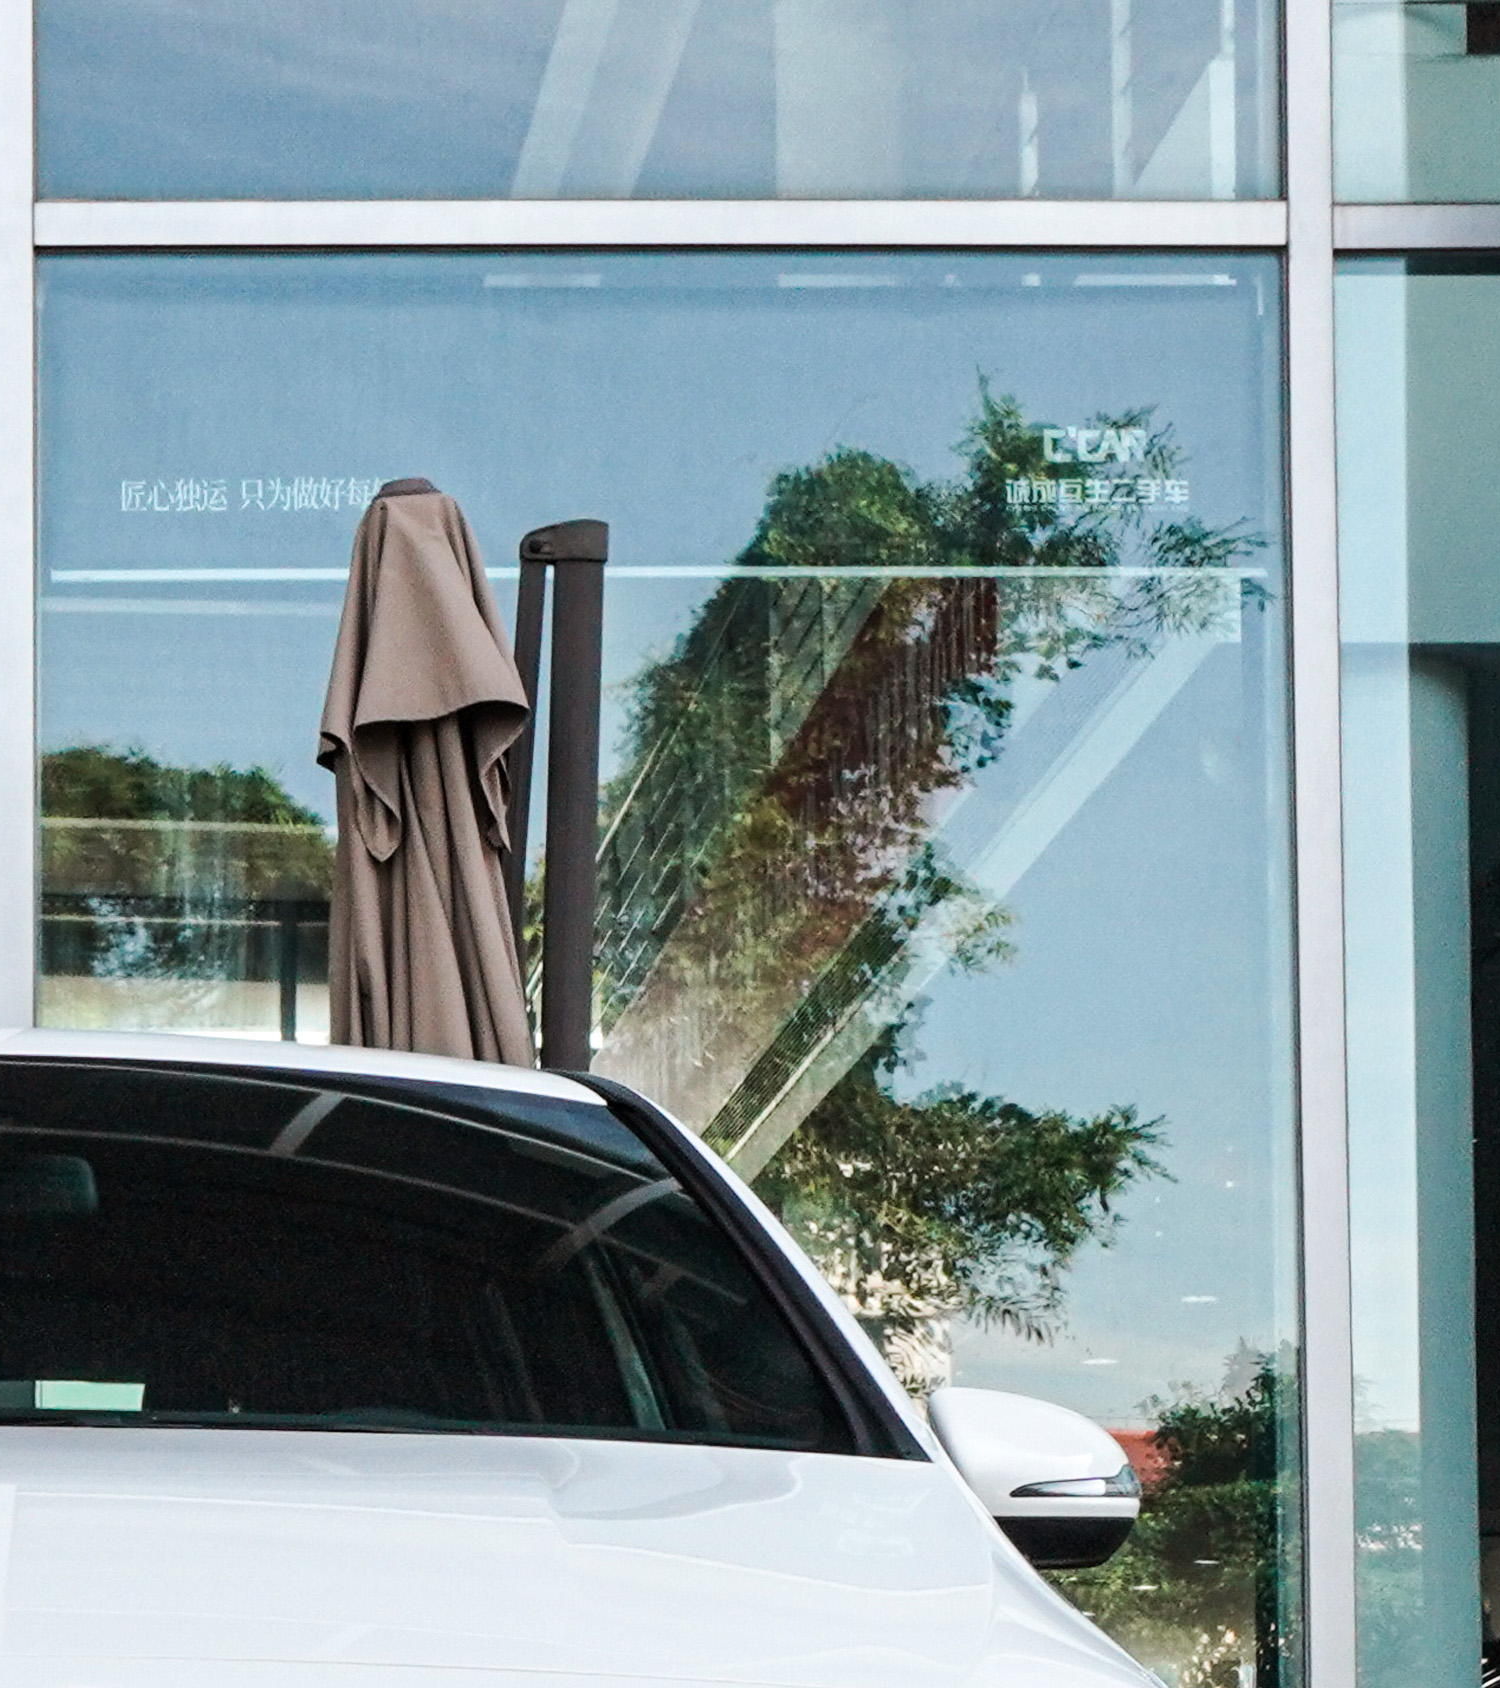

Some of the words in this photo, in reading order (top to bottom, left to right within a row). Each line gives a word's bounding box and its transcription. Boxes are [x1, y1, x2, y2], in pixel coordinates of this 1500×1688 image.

[120, 478, 228, 512] 匠心独运
[241, 475, 385, 512] 只为做好每
[1005, 477, 1189, 505] 诚成互生二手车
